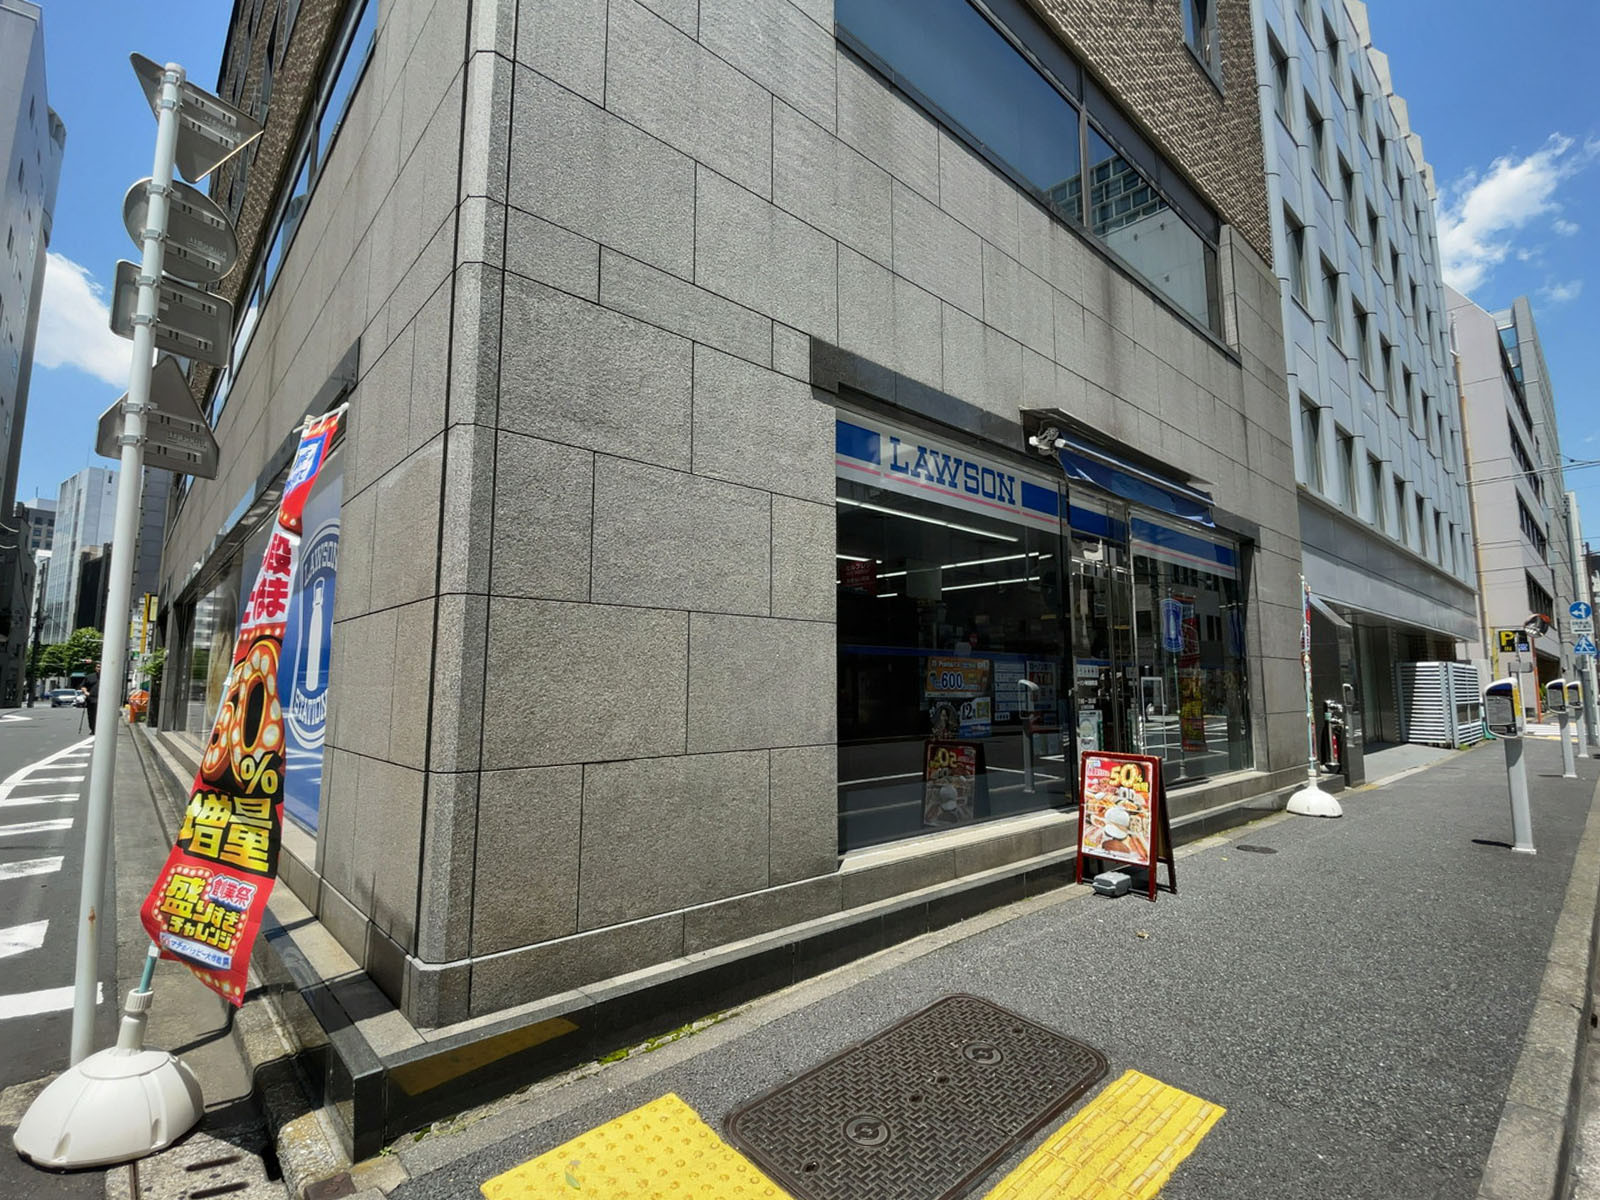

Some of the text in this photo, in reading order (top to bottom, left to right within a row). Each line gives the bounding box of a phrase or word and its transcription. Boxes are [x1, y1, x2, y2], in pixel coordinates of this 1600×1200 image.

[889, 436, 1016, 505] LAWSON
[1500, 631, 1514, 646] P
[941, 671, 963, 689] 600
[179, 792, 273, 873] 増量
[160, 873, 242, 933] 盛りすぎ
[211, 876, 254, 907] 創業祭
[168, 916, 232, 951] チャレンジ
